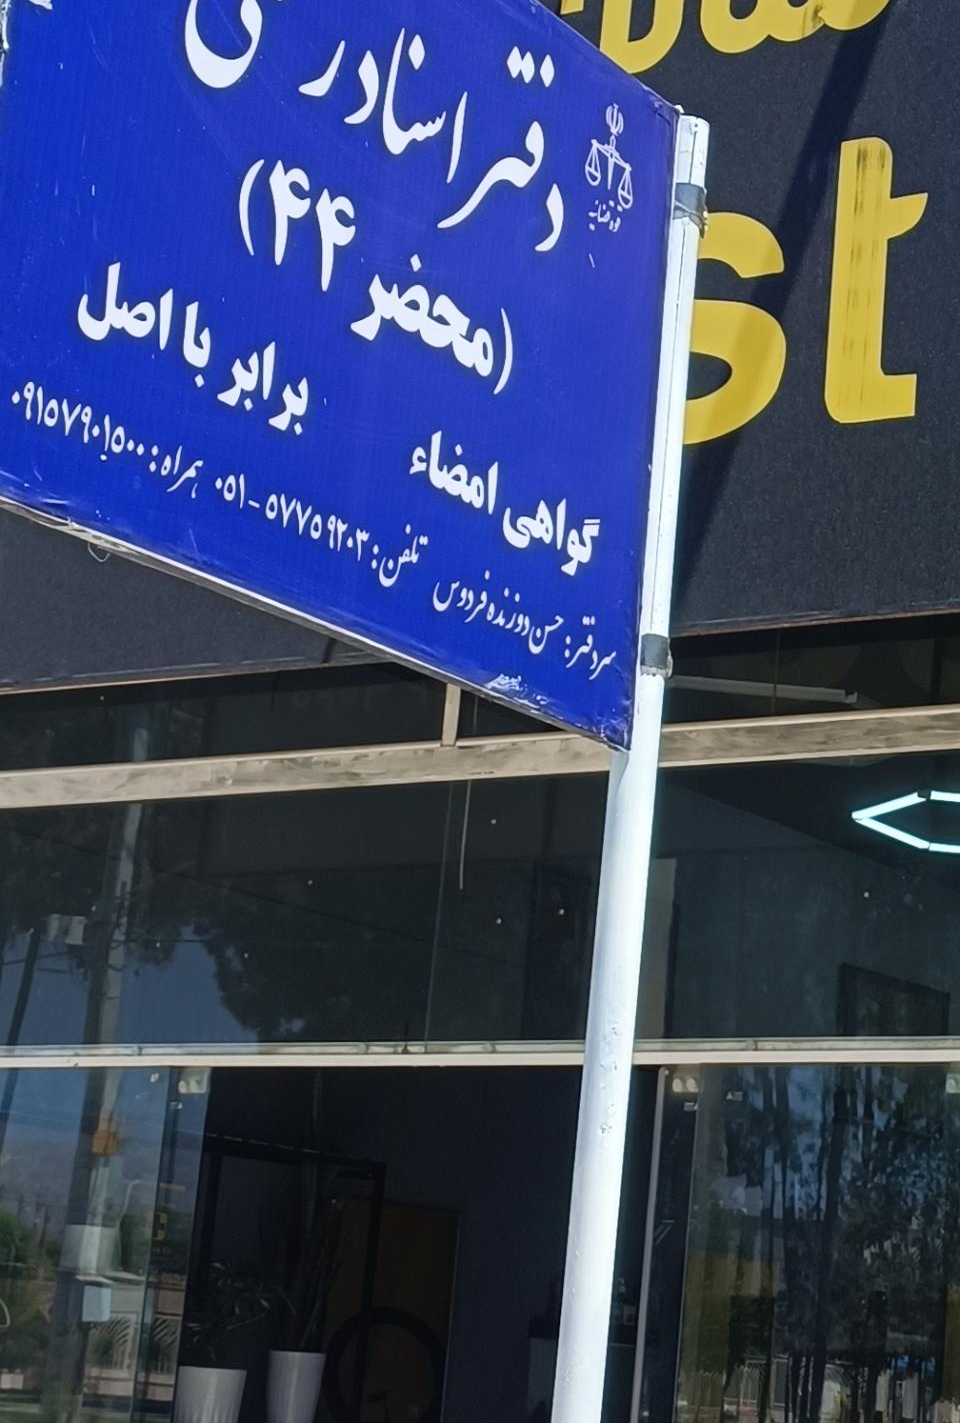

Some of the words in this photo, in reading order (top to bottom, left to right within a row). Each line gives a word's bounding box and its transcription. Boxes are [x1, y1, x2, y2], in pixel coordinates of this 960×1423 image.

[344, 27, 467, 183] اسناد
[438, 45, 564, 252] دفتر
[77, 262, 173, 350] اصل
[182, 301, 212, 387] با
[218, 342, 309, 435] برابر
[409, 431, 498, 516] امضاء
[502, 500, 600, 576] گواهی
[432, 570, 488, 624] فردوس
[528, 615, 564, 655] حسن
